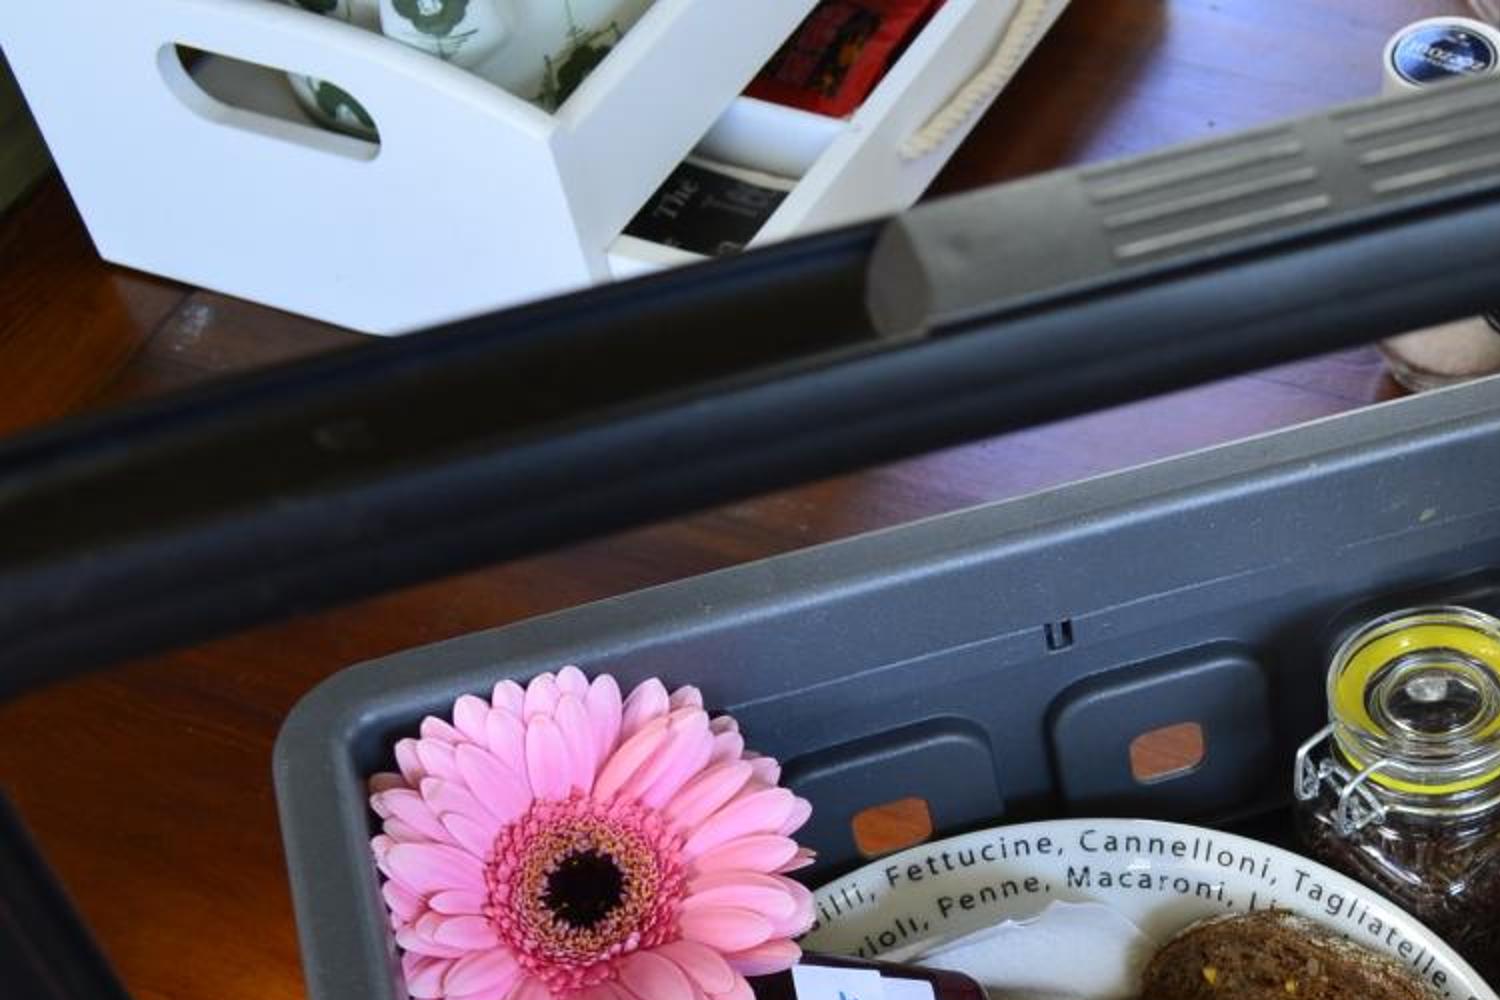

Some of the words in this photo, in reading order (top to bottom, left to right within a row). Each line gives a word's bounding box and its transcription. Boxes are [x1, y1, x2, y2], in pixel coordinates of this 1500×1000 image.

[812, 882, 877, 930] illi,
[885, 835, 1064, 886] Fettucine,
[1079, 829, 1278, 884] Cannelloni,
[1294, 869, 1451, 998] Tagliatelle,
[936, 874, 1051, 918] Penne,
[1066, 865, 1233, 908] Macaroni,
